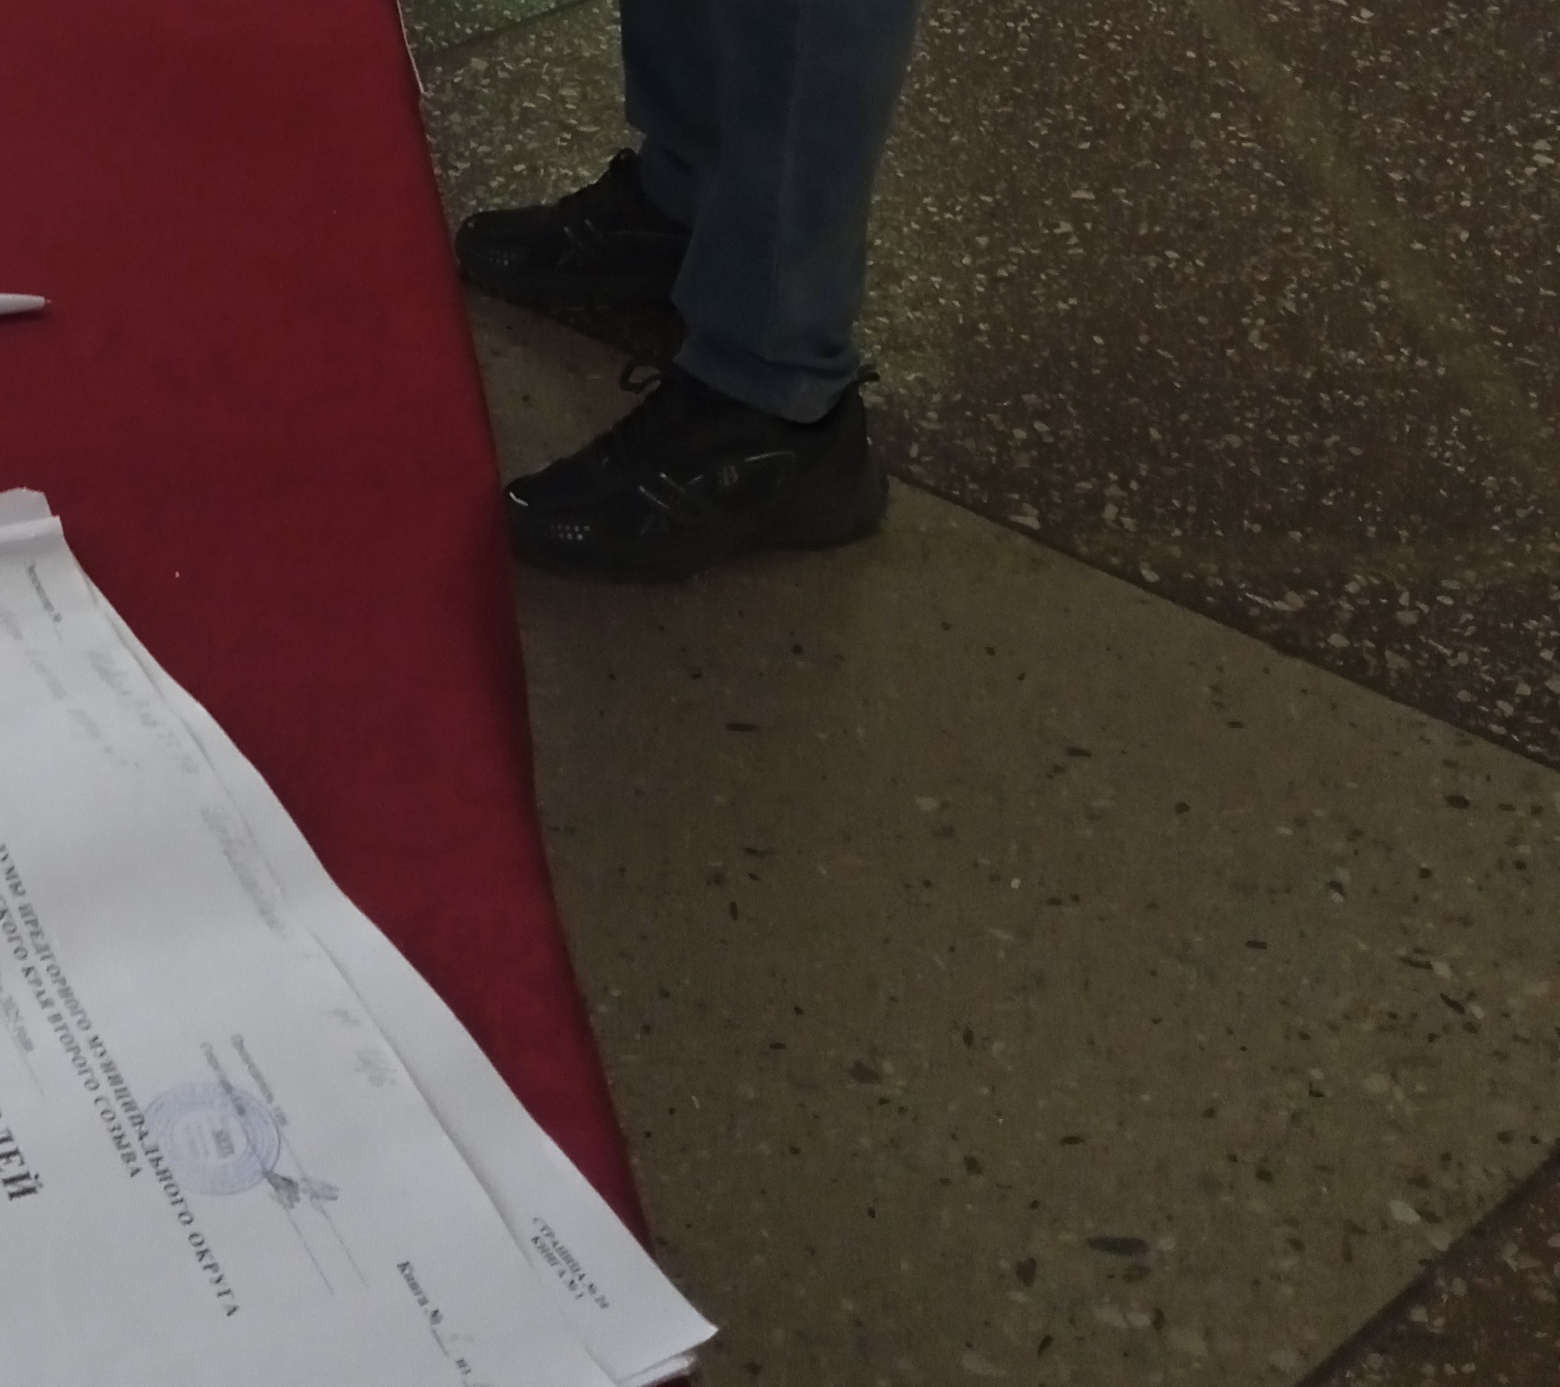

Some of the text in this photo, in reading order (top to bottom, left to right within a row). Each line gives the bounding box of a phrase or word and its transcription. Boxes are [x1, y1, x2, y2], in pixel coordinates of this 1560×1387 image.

[20, 963, 56, 1010] КРАЯ
[46, 1010, 101, 1093] ВТОРОГО
[91, 1094, 145, 1179] СОЗЫВА
[16, 902, 92, 1032] ПРЕДГОРНОГО
[84, 1035, 195, 1228] МУНИЦИПАЛЬНОГО
[185, 1230, 243, 1319] ОКРУГА
[528, 1235, 569, 1278] КНИГА
[530, 1215, 589, 1282] СТРАНИЦА
[395, 1260, 429, 1306] Книга
